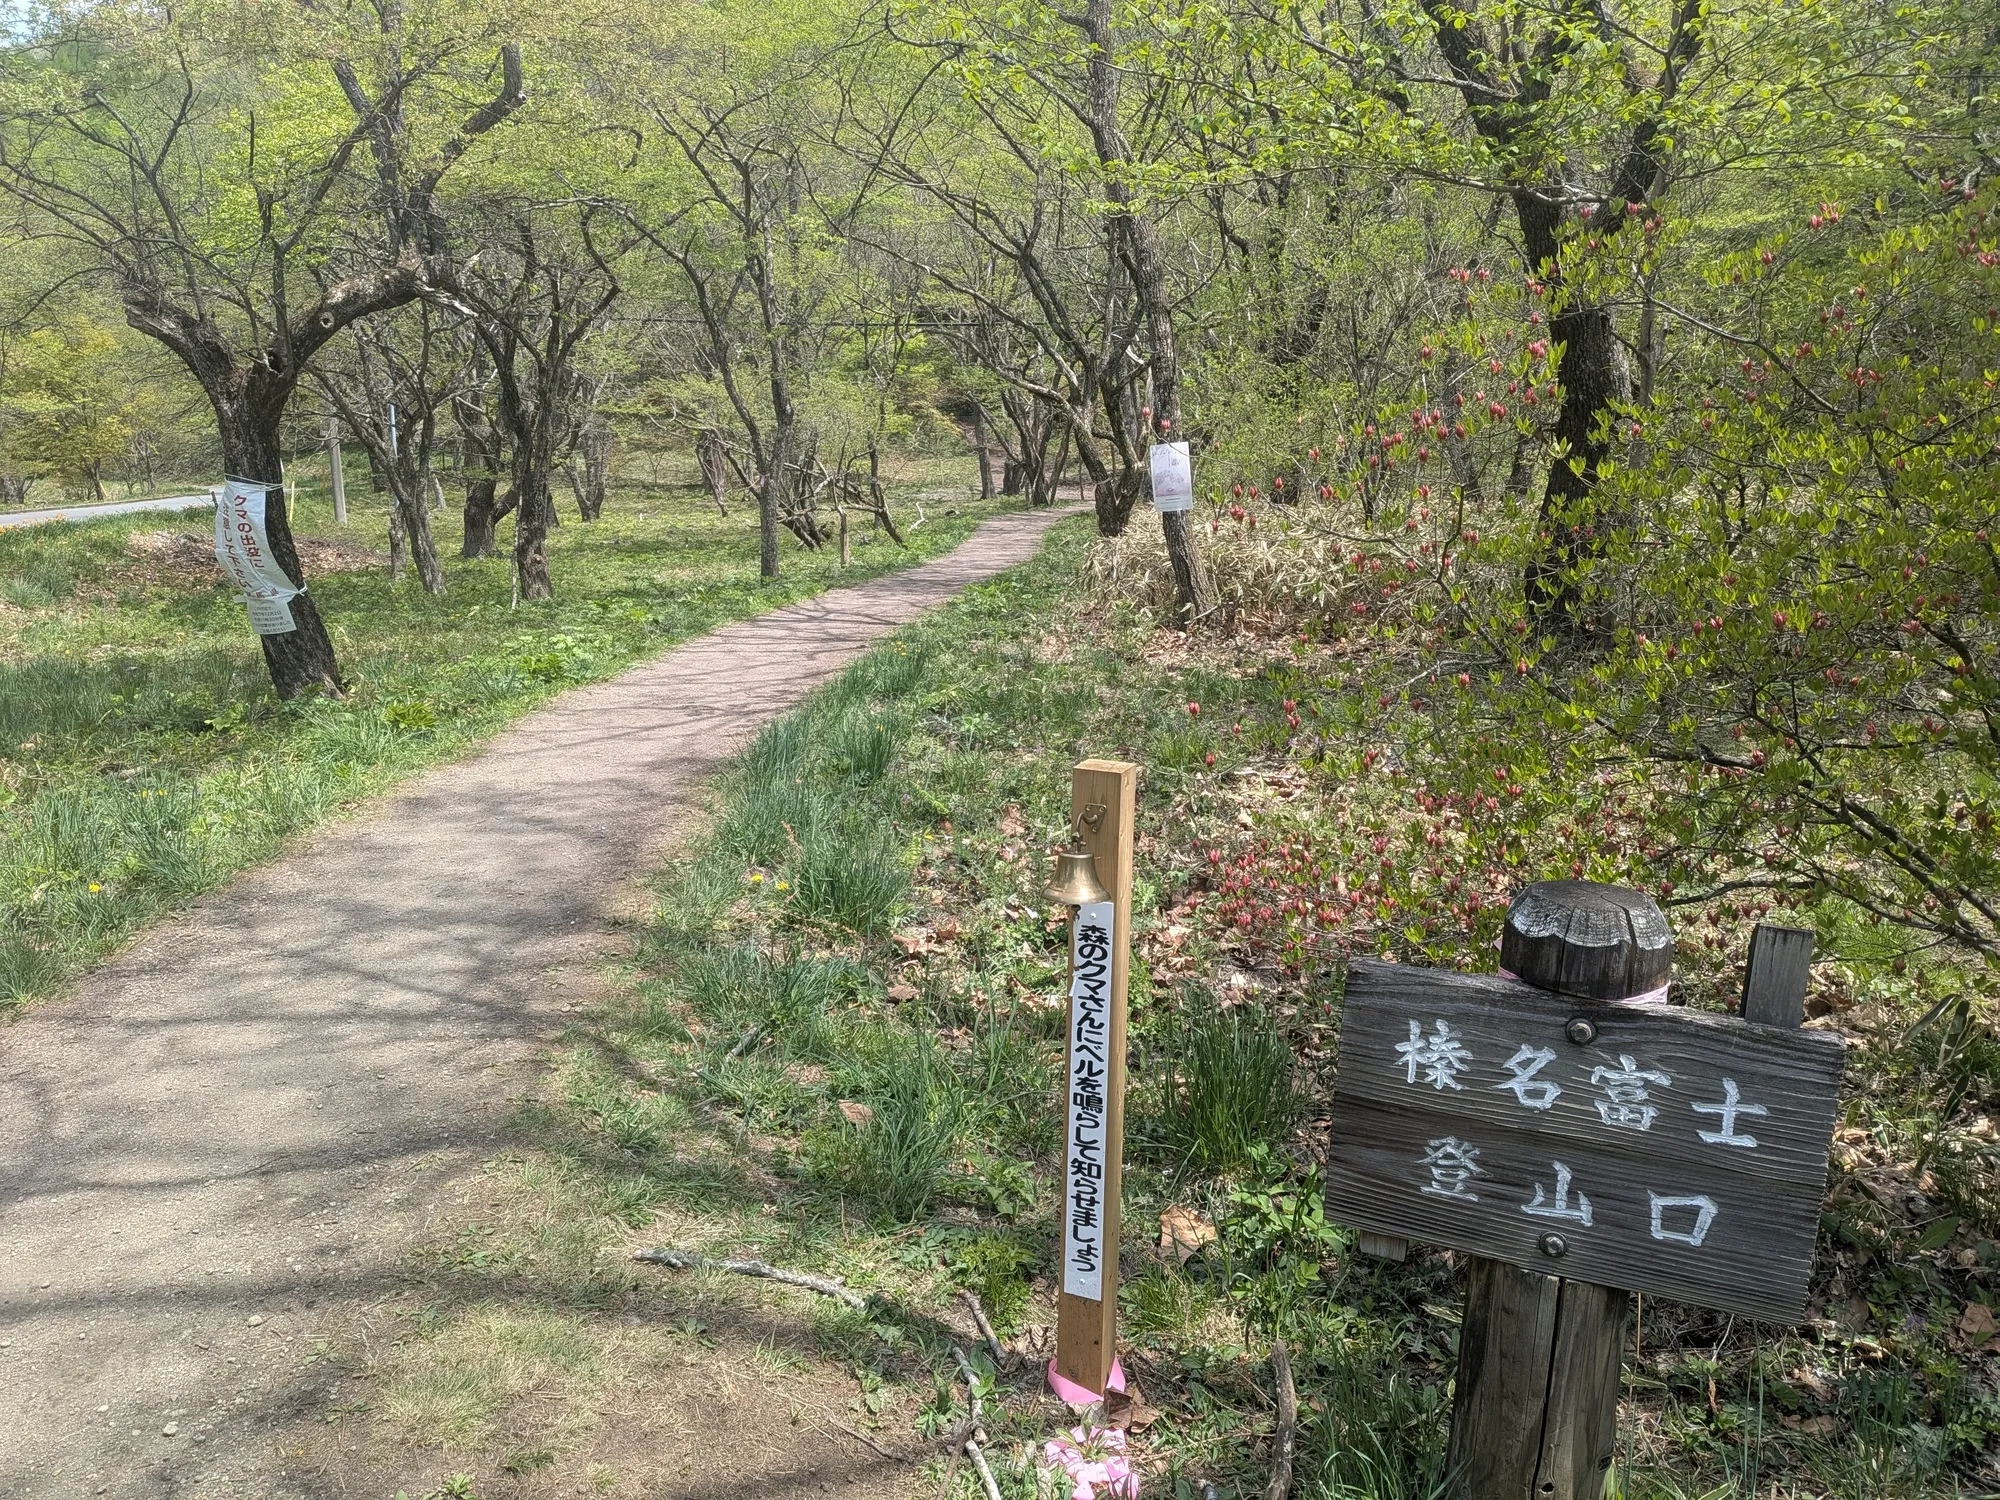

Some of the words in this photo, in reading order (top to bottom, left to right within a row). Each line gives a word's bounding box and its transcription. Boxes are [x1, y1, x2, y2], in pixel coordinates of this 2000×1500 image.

[234, 494, 264, 568] クマの出没に
[1070, 924, 1111, 1272] 森のクマさんにベルを鳴らして知らせましょう
[1393, 1018, 1770, 1149] 榛名富士
[1415, 1135, 1720, 1247] 登山口
